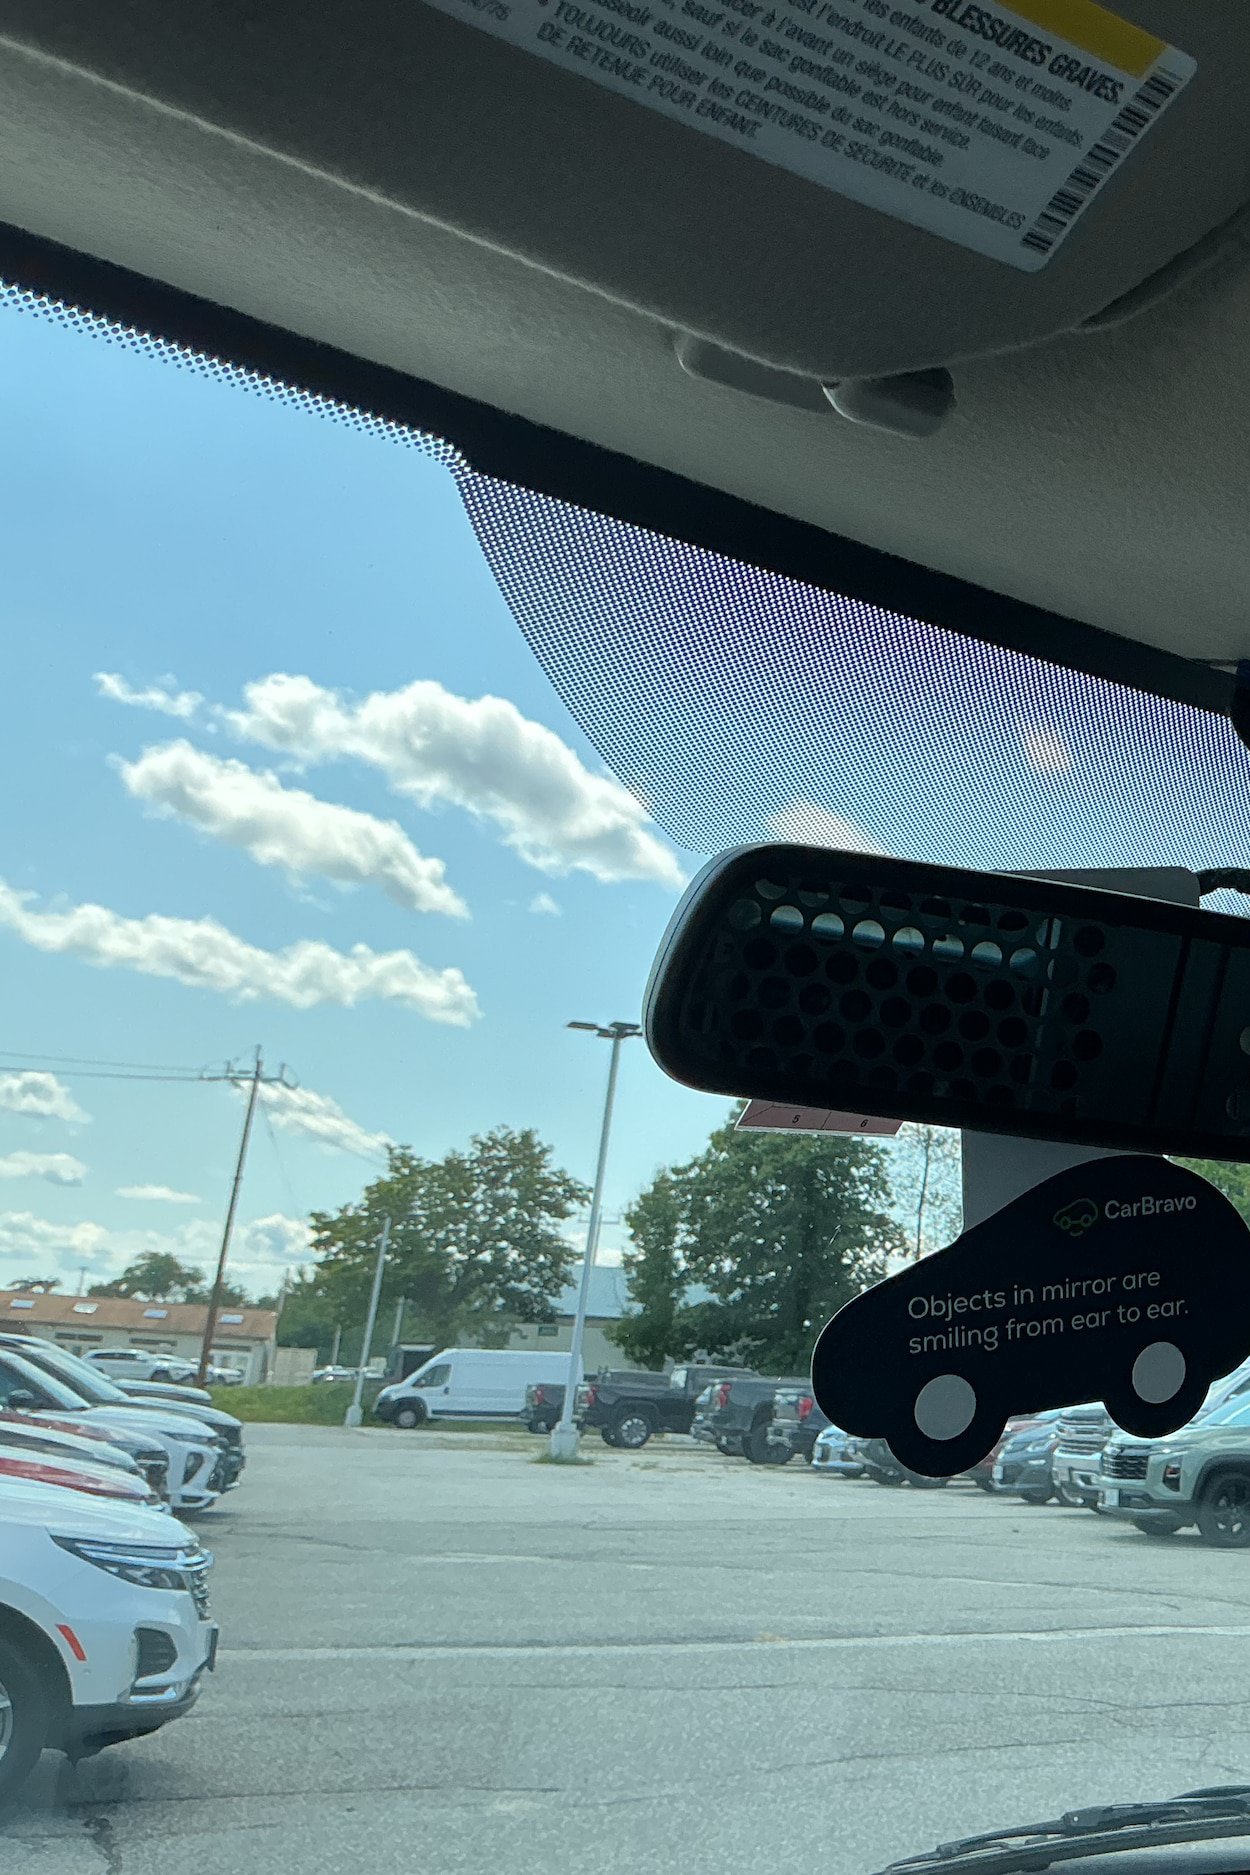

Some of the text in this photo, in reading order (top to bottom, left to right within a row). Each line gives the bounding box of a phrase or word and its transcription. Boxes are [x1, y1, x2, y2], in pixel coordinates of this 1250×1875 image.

[537, 22, 567, 47] DE
[566, 36, 650, 86] RETENUE
[647, 75, 697, 109] POUR
[739, 27, 759, 47] le
[759, 39, 790, 63] sac
[788, 55, 862, 98] gonflable
[861, 90, 889, 112] est
[886, 99, 921, 126] hors
[816, 3, 886, 50] l'endroit
[884, 39, 910, 62] LE
[906, 50, 950, 82] PLUS
[977, 88, 1015, 113] pour
[1012, 102, 1035, 124] les
[863, 0, 890, 18] les
[889, 11, 947, 48] enfants
[946, 40, 967, 59] de
[969, 49, 991, 70] 12
[987, 62, 1016, 84] ans
[1015, 75, 1033, 92] et
[931, 0, 1053, 67] BLESSURES
[554, 2, 651, 58] TOUJOURS
[649, 51, 709, 87] utiliser
[707, 77, 735, 101] les
[735, 89, 823, 141] CEINTURES
[820, 130, 846, 152] DE
[912, 174, 930, 190] et
[928, 178, 951, 198] les
[948, 187, 1026, 230] ENSEMBLES
[653, 19, 703, 52] aussi
[700, 41, 733, 68] loin
[734, 60, 767, 83] que
[764, 76, 831, 114] possible
[831, 106, 854, 125] du
[852, 117, 880, 138] sac
[776, 16, 833, 56] l'avant
[832, 48, 855, 68] un
[894, 81, 934, 104] pour
[932, 98, 980, 127] enfant
[1021, 137, 1050, 160] face
[792, 1115, 868, 1128] 5 6
[1104, 1195, 1197, 1219] CarBravo
[907, 1271, 1161, 1321] Objects in mirror are
[908, 1299, 1189, 1355] smiling from ear to ear.
